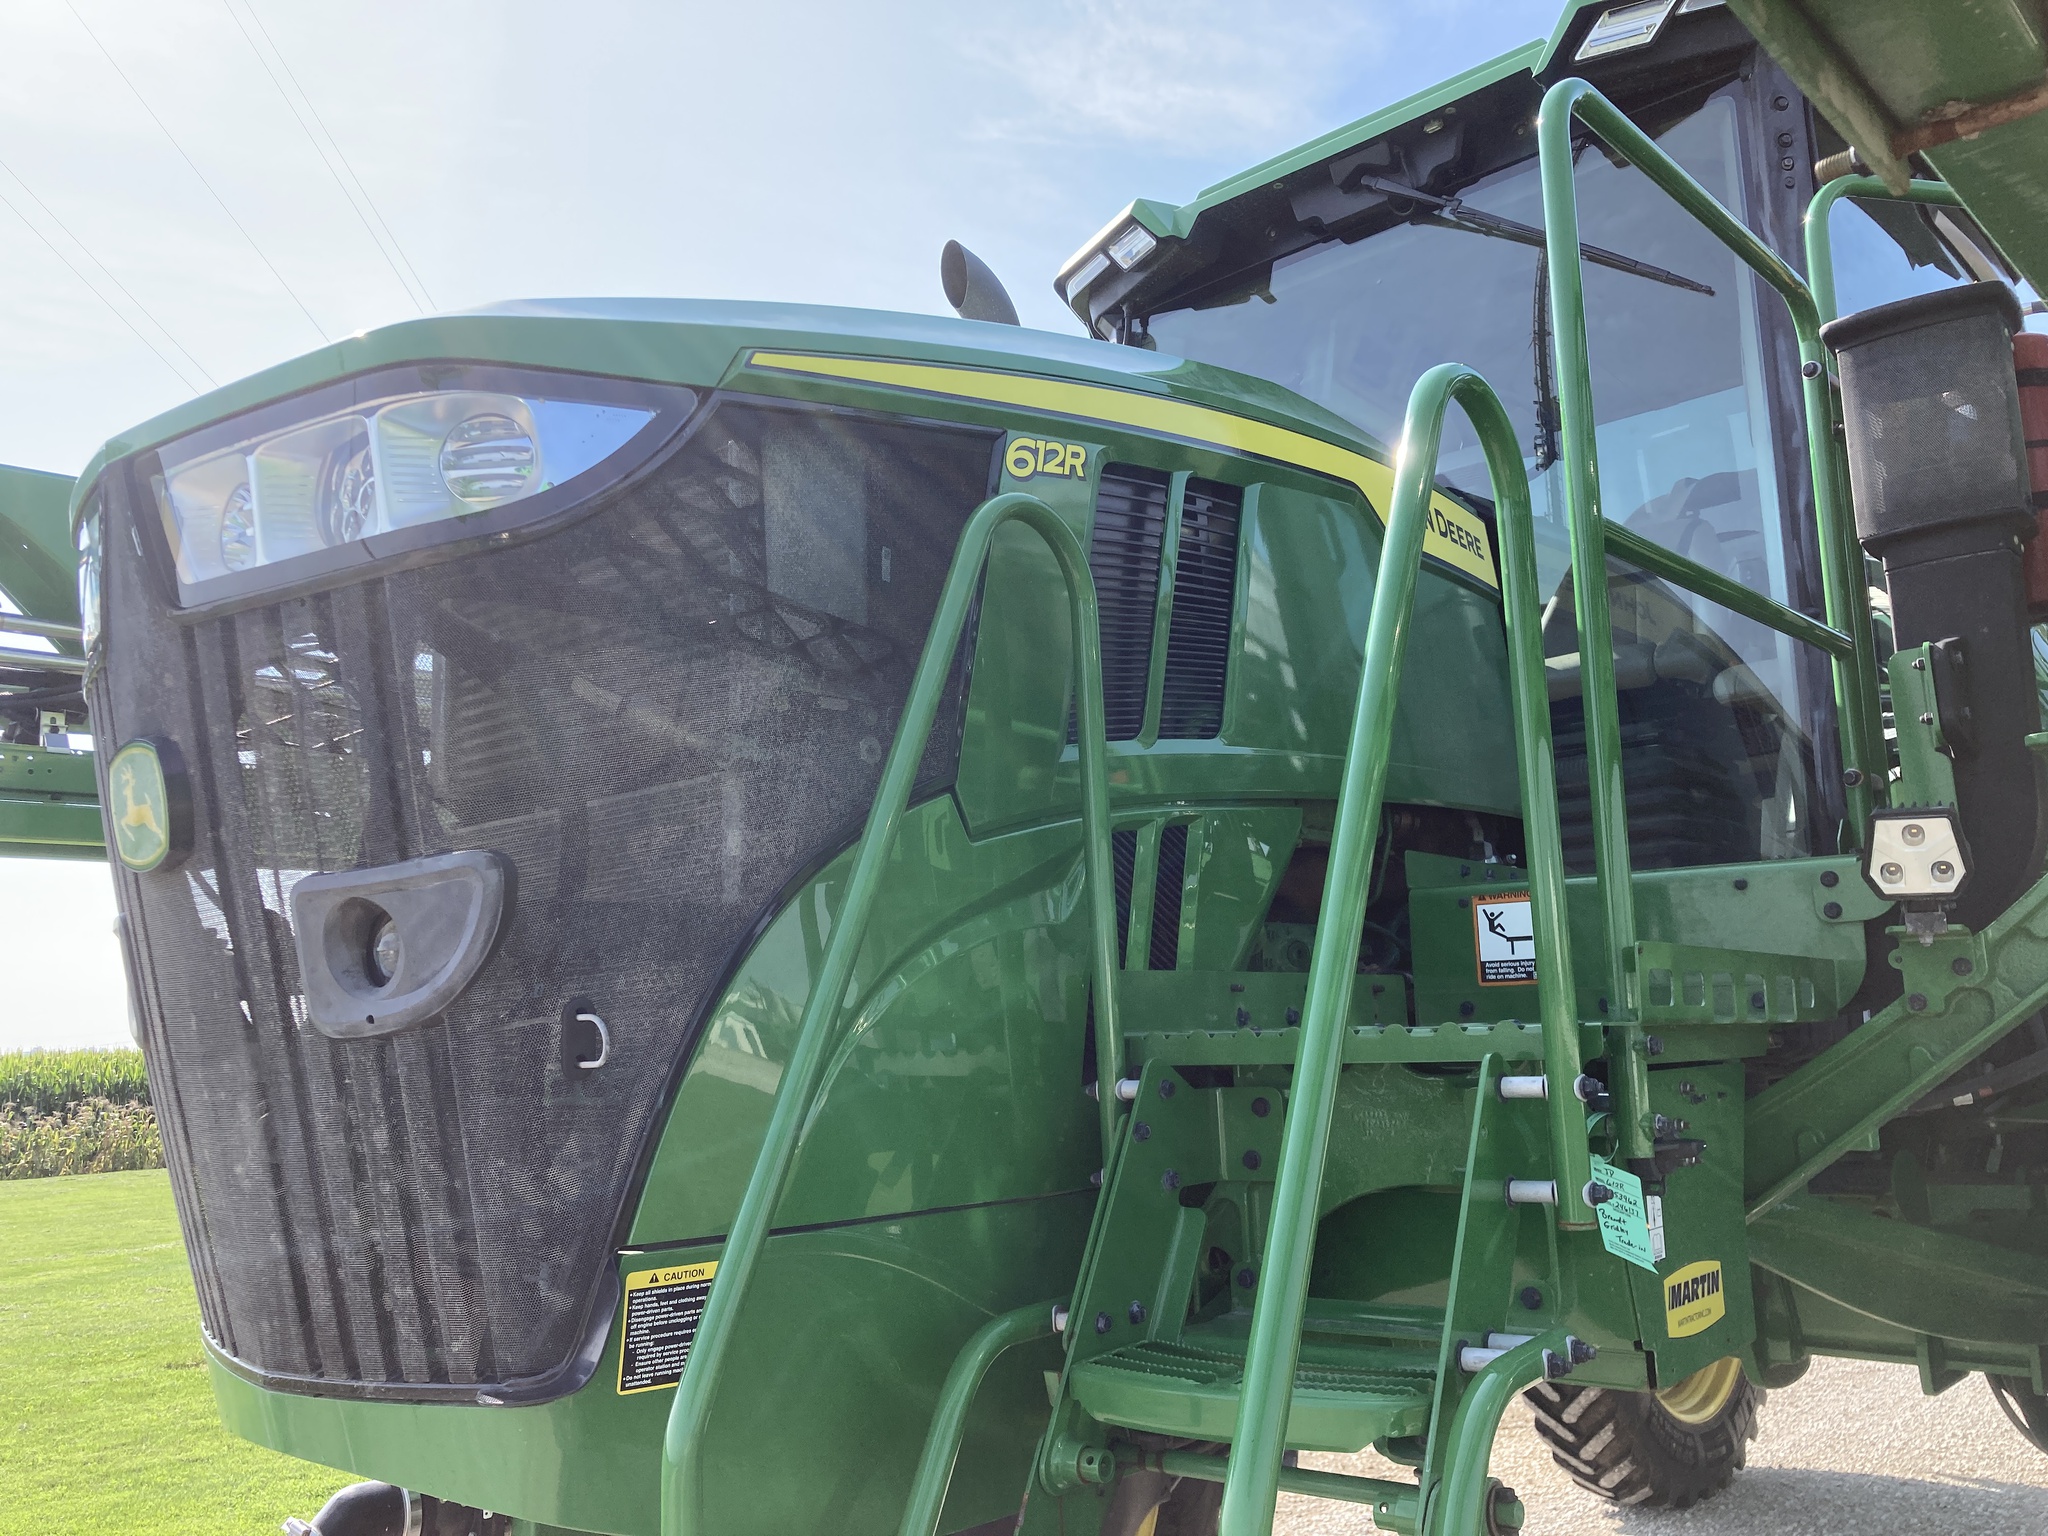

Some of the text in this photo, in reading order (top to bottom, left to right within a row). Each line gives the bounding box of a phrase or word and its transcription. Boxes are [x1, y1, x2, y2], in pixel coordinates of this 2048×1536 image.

[1005, 437, 1087, 482] 612R
[1434, 508, 1485, 560] DEERE
[1606, 1179, 1624, 1191] 612R
[664, 1269, 704, 1281] CAUTION
[686, 1283, 700, 1291] during
[1669, 1270, 1719, 1311] MARTIN
[632, 1308, 660, 1317] power-driven
[655, 1311, 684, 1320] power-driven
[651, 1332, 673, 1340] procedure
[626, 1379, 651, 1387] unattended.
